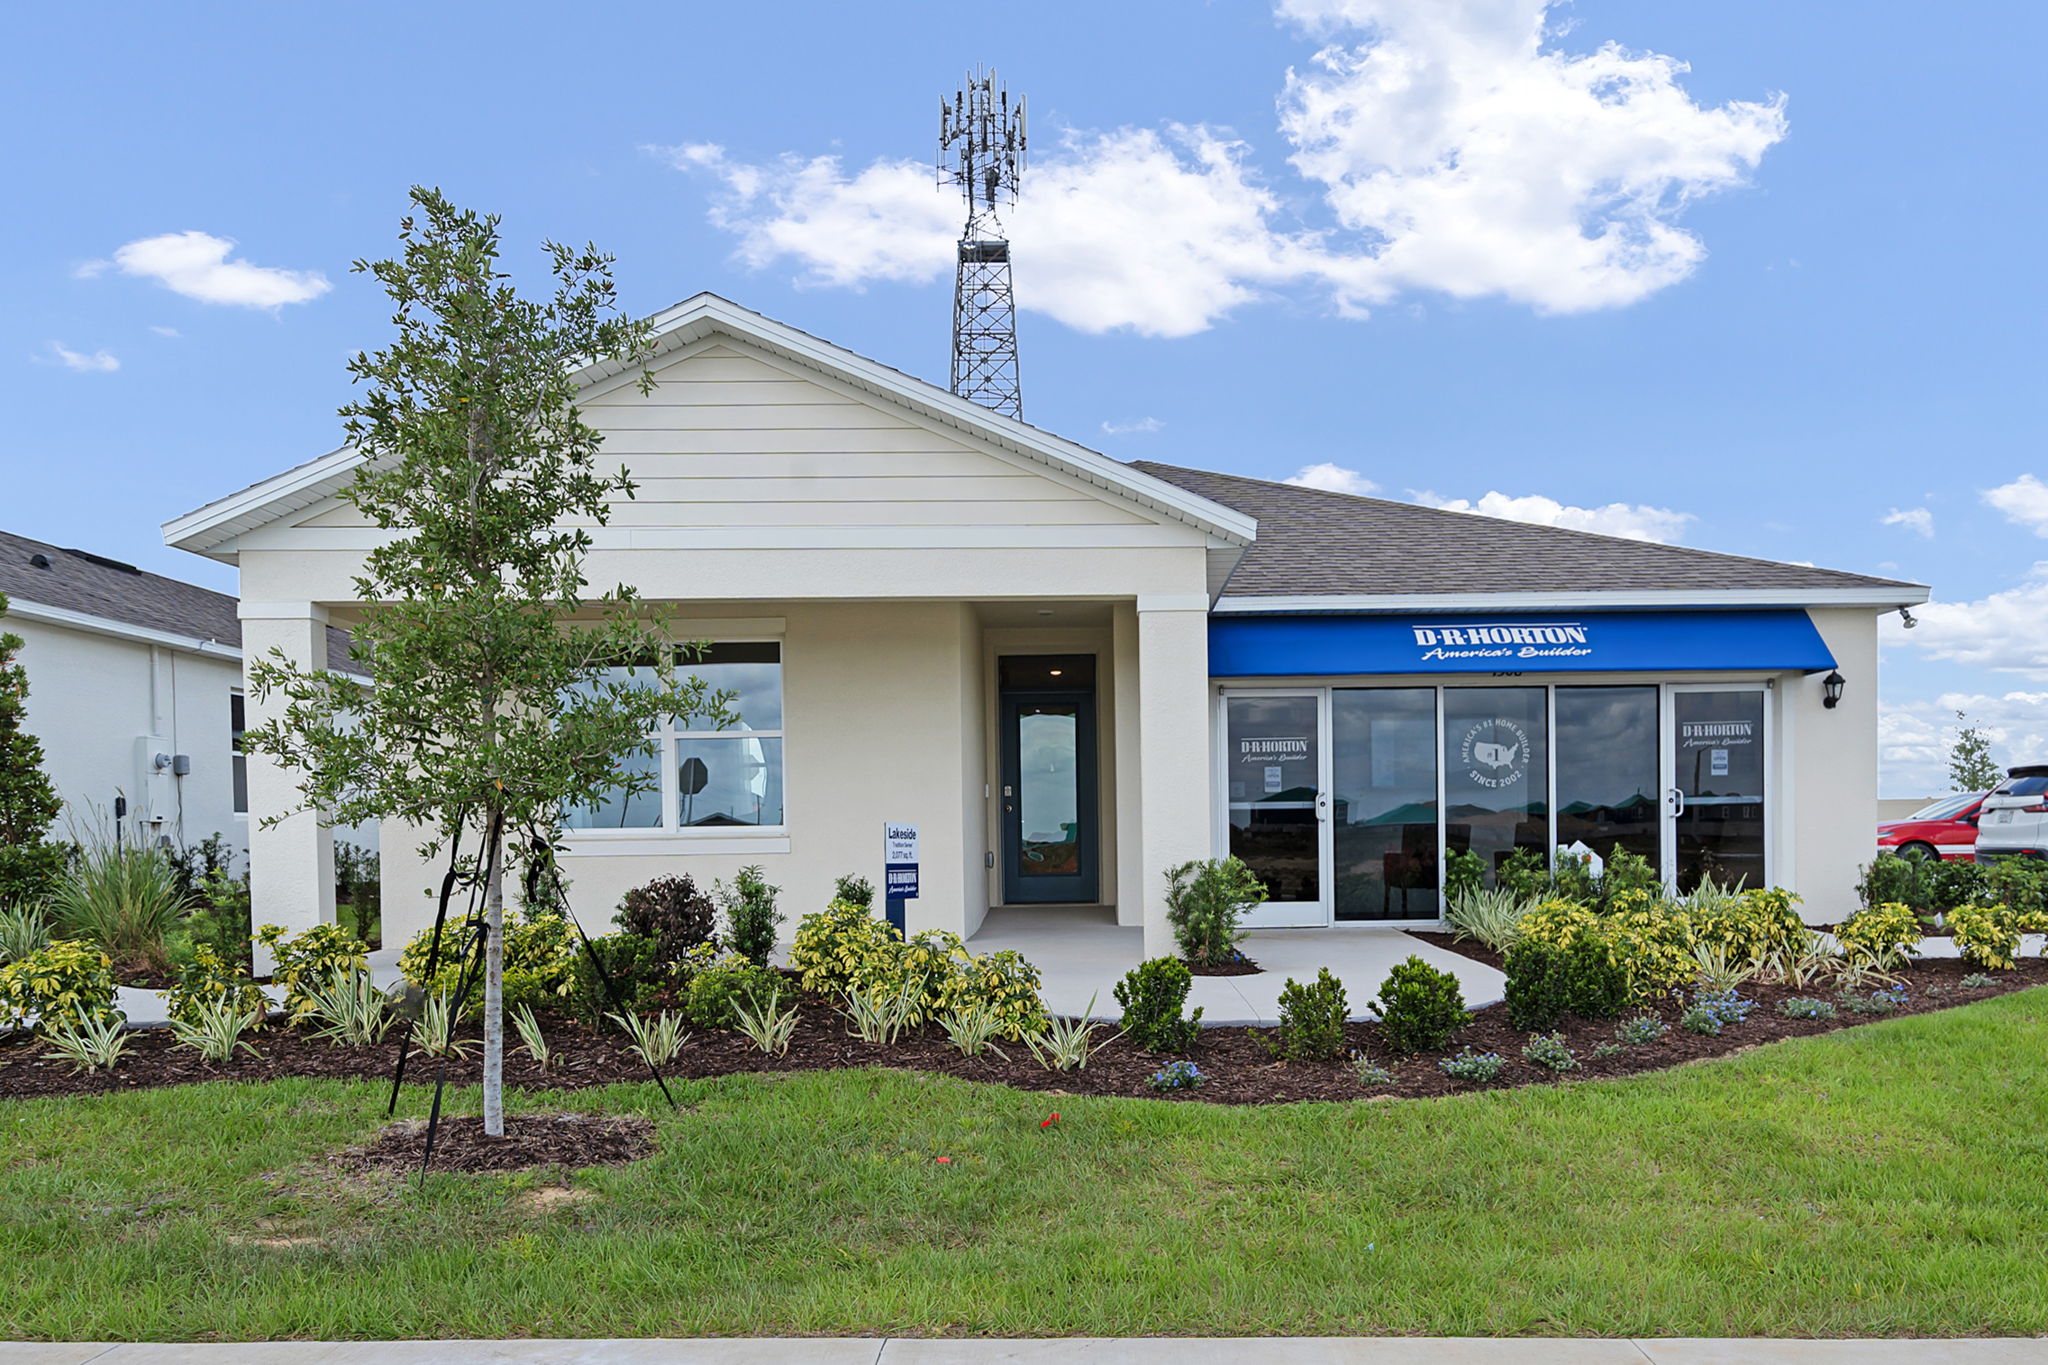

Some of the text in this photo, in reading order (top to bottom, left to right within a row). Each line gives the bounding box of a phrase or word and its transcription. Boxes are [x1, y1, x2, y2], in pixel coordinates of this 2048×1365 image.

[1421, 646, 1591, 661] America's Builder
[1462, 724, 1482, 763] AMERICA'S
[1495, 718, 1517, 732] HOME
[1515, 730, 1530, 764] BUILDER
[1683, 738, 1752, 747] America's Builder
[1241, 753, 1307, 763] America's Builder
[1469, 770, 1522, 788] SINCE 2002
[888, 827, 917, 840] Lakeside
